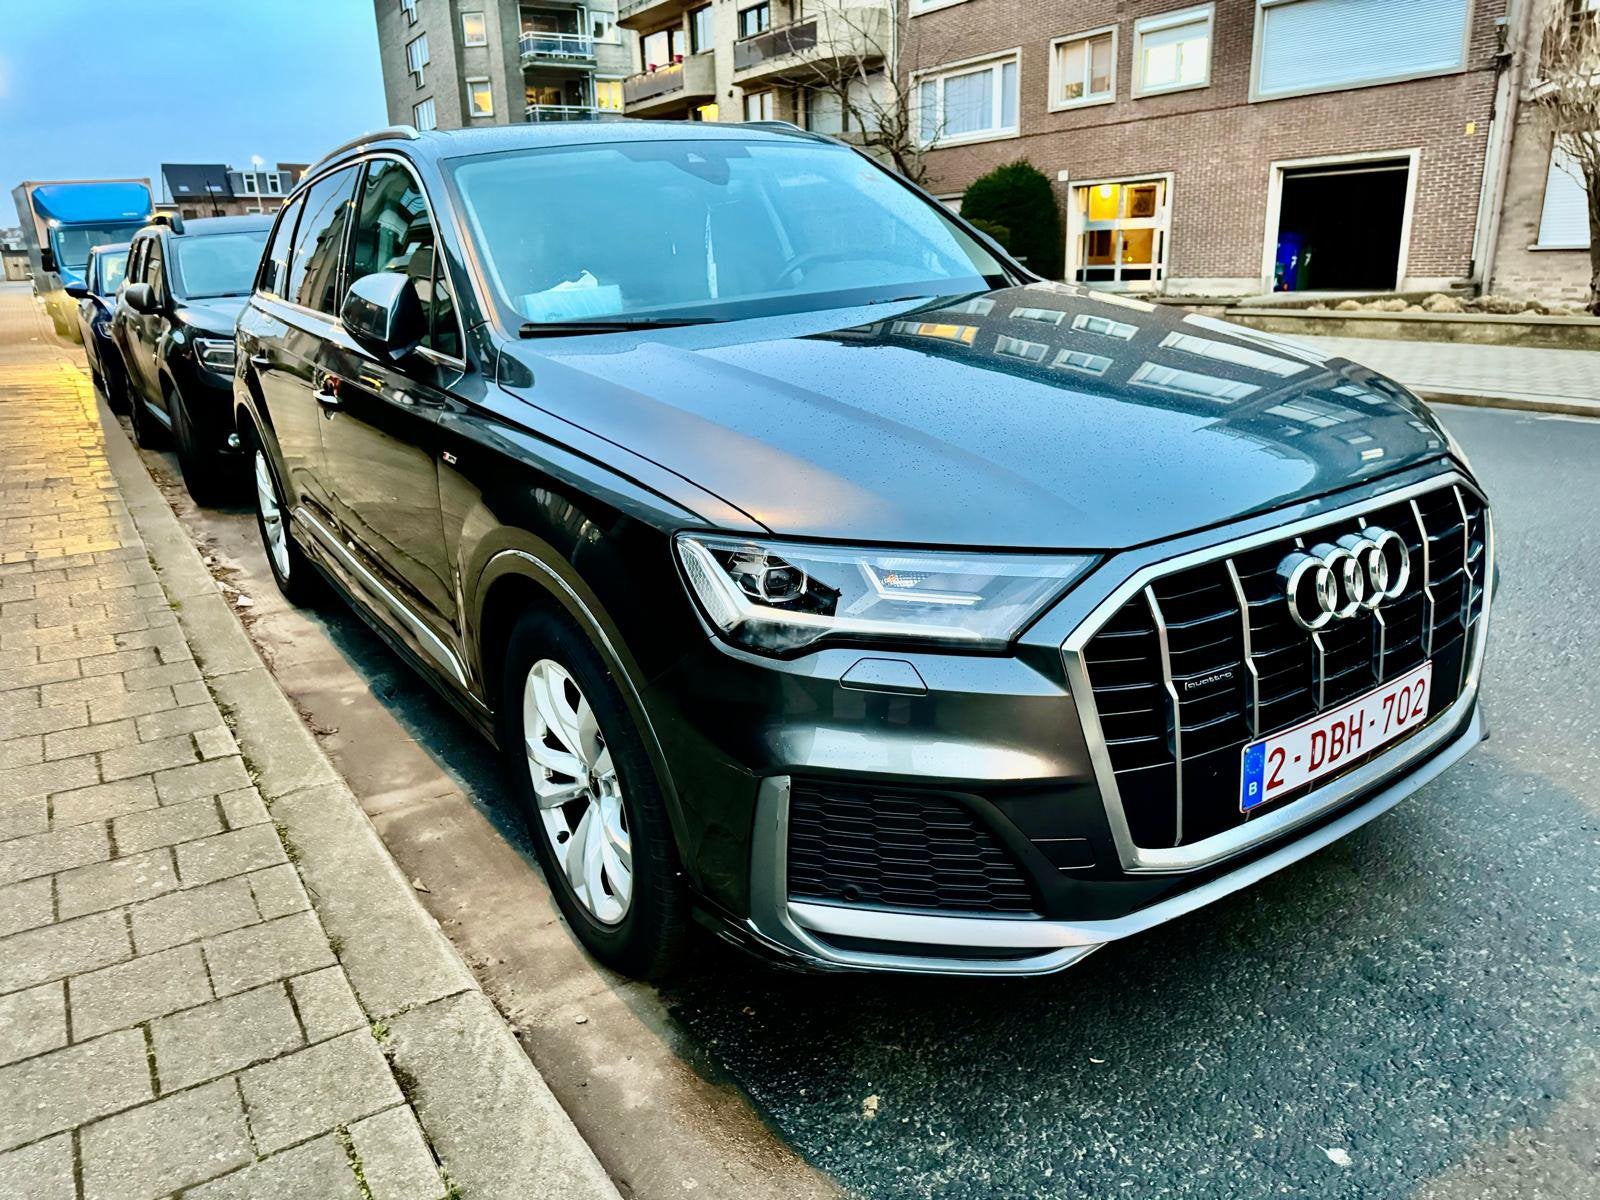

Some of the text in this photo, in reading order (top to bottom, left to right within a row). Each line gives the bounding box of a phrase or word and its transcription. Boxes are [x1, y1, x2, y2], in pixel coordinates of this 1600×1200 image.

[1185, 672, 1233, 691] quattro
[1266, 678, 1425, 791] 2-DBH-702
[1248, 781, 1258, 797] B
